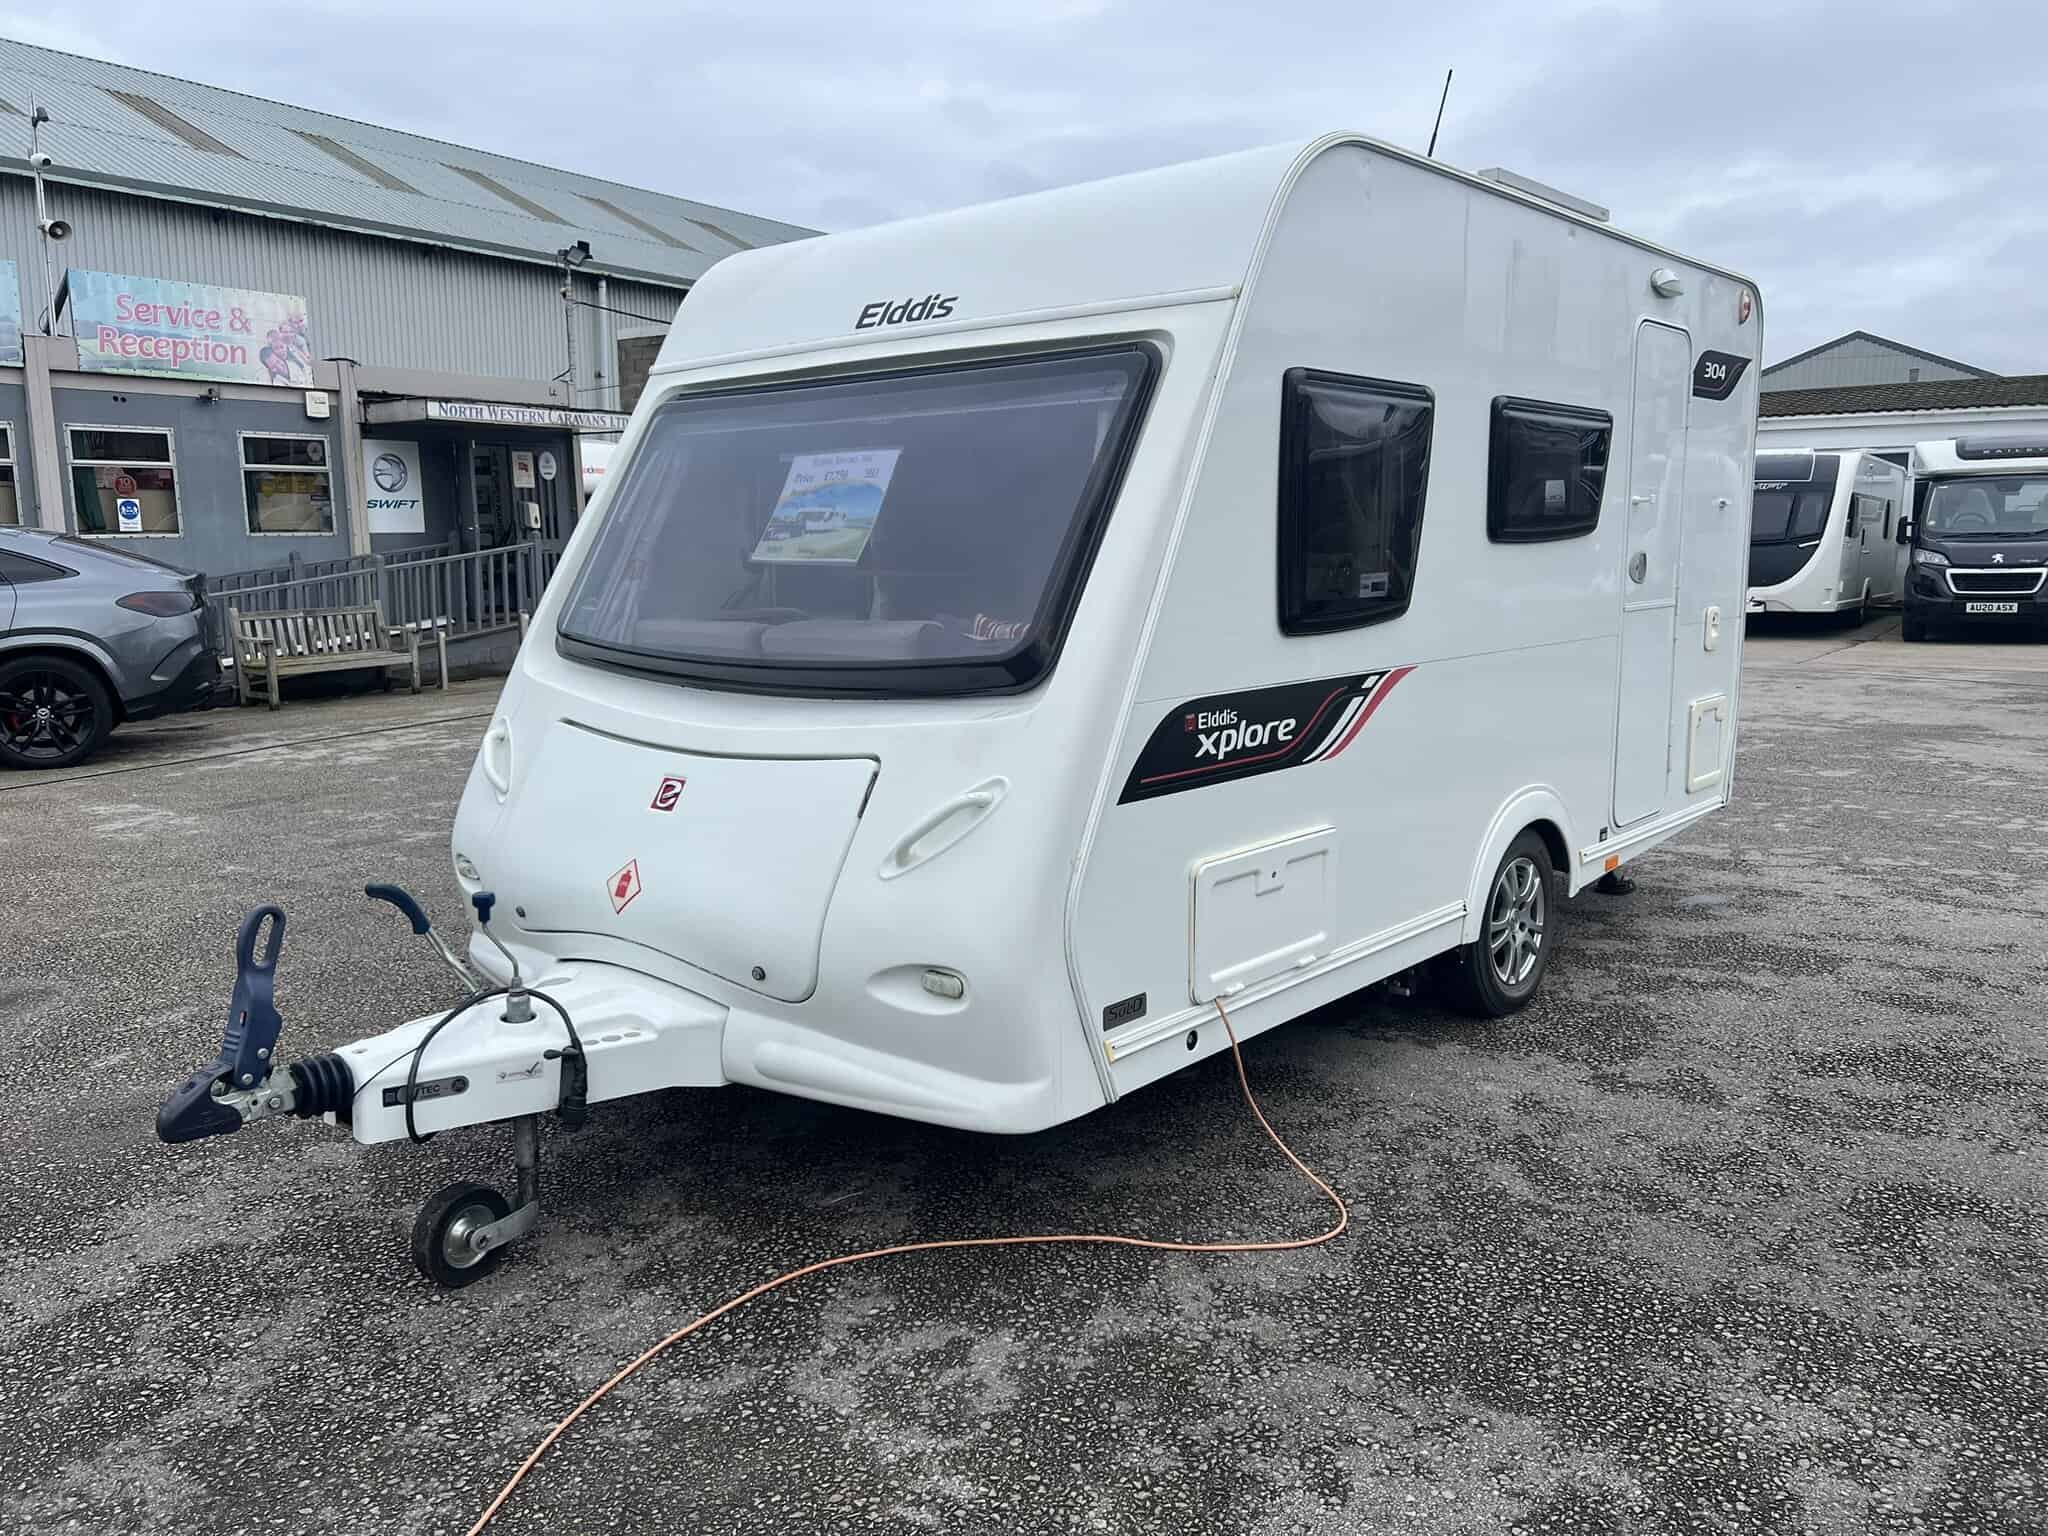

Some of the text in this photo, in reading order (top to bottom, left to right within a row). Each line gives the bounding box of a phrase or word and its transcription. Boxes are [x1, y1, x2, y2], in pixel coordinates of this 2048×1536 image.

[115, 293, 252, 335] Service &
[855, 293, 959, 329] Elddis
[97, 325, 248, 369] Reception
[1703, 361, 1726, 381] 304
[438, 401, 484, 418] NORTH
[488, 404, 545, 423] WESTERN
[549, 408, 608, 426] CARAVANS
[367, 499, 420, 510] SWIFT
[1198, 708, 1238, 729] Elddis
[1194, 717, 1297, 760] xplore
